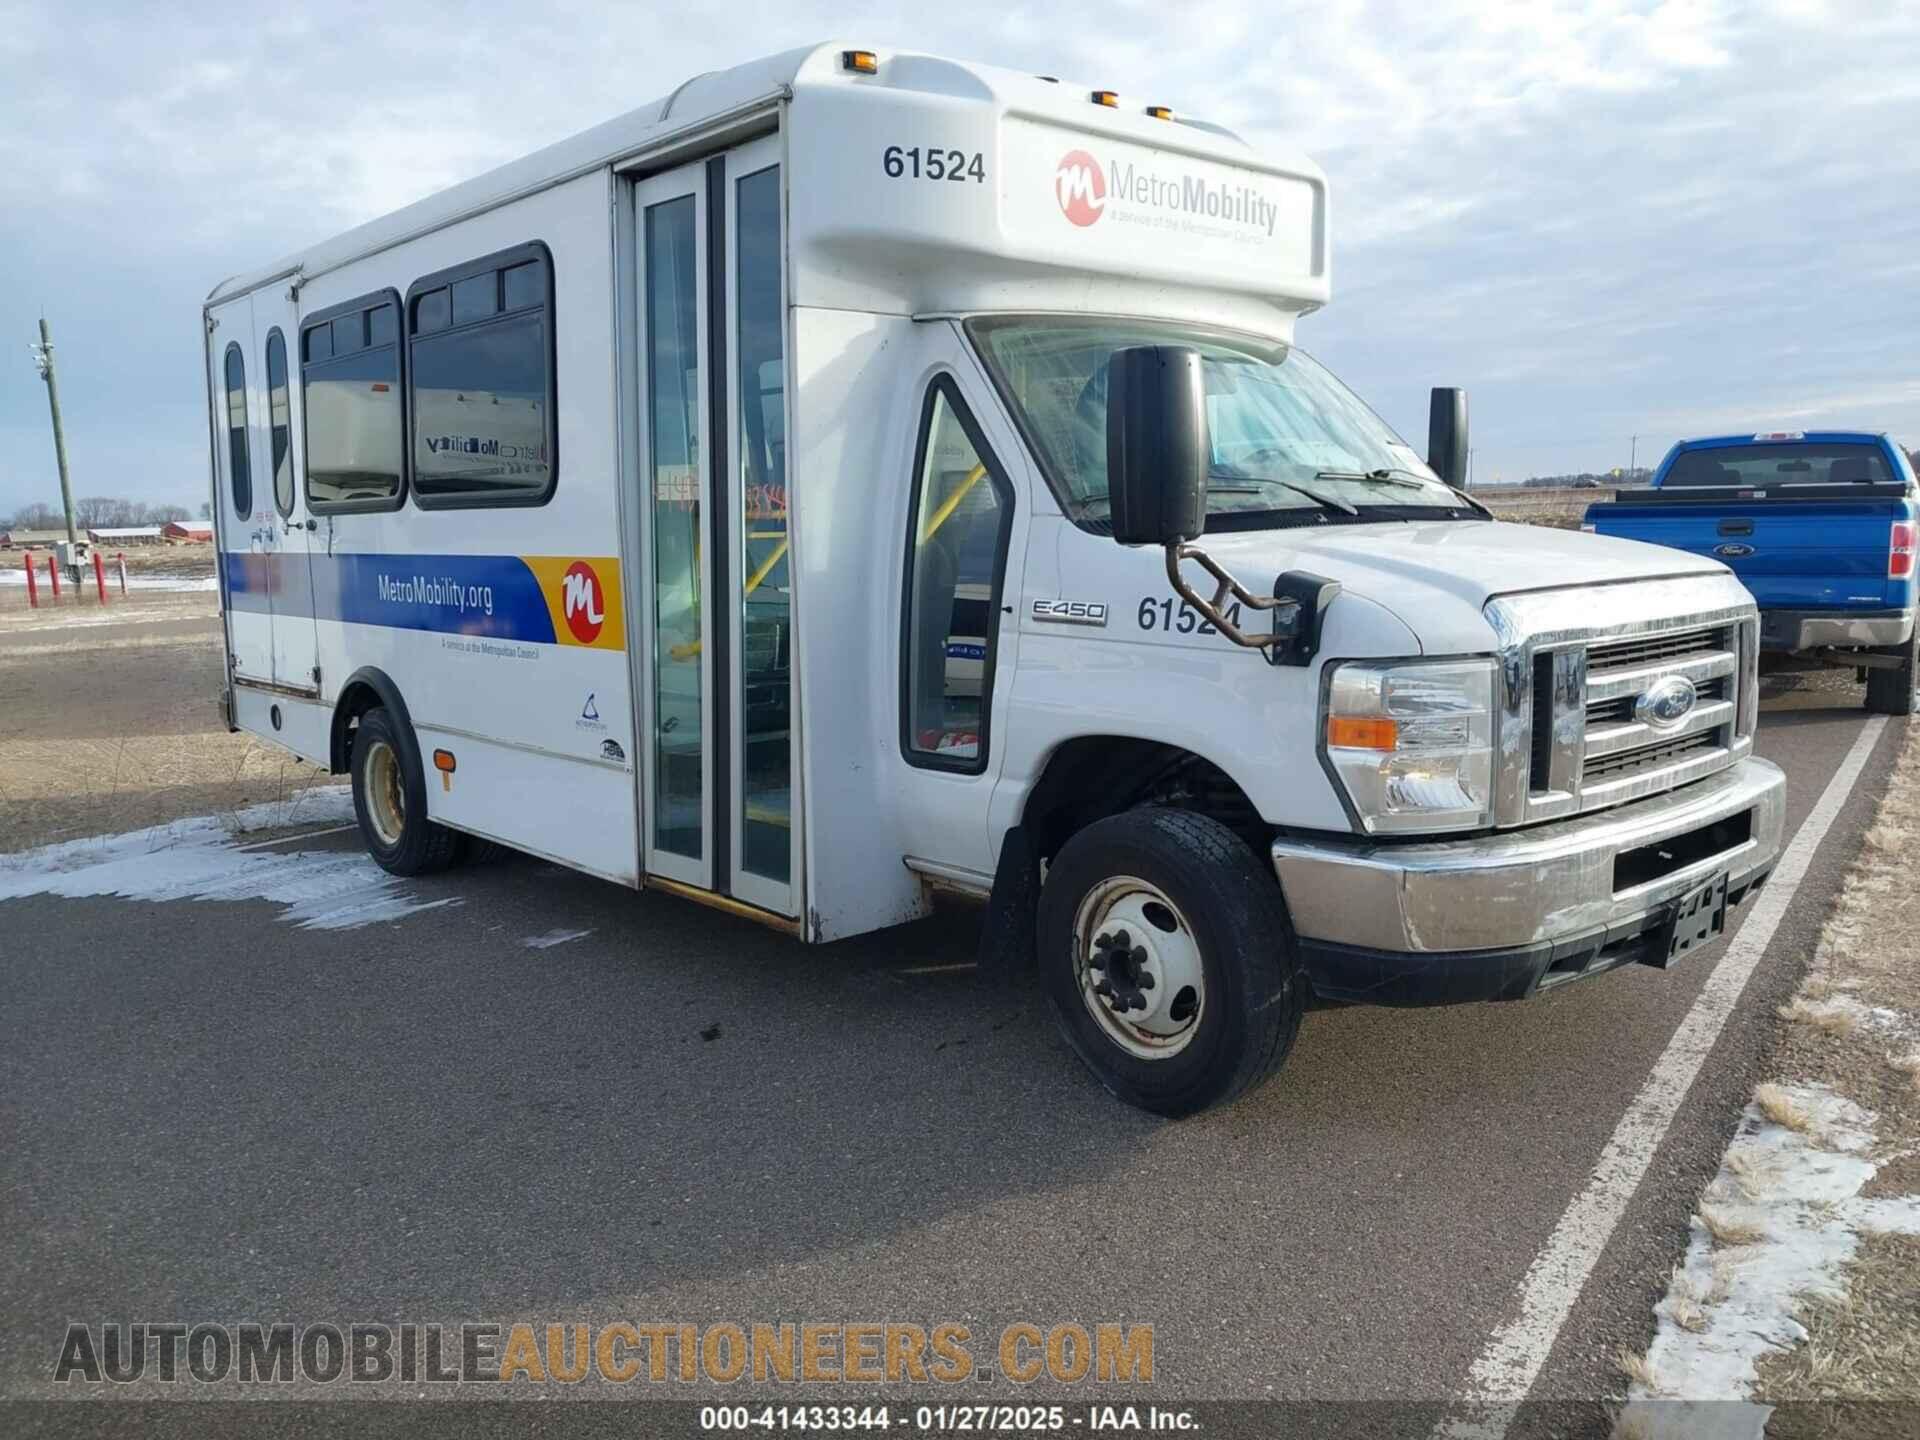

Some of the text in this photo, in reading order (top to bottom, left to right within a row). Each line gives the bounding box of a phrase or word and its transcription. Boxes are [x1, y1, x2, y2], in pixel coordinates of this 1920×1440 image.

[884, 146, 985, 183] 61524
[1110, 160, 1278, 237] MetroMobility
[378, 574, 493, 616] MetroMobility.org
